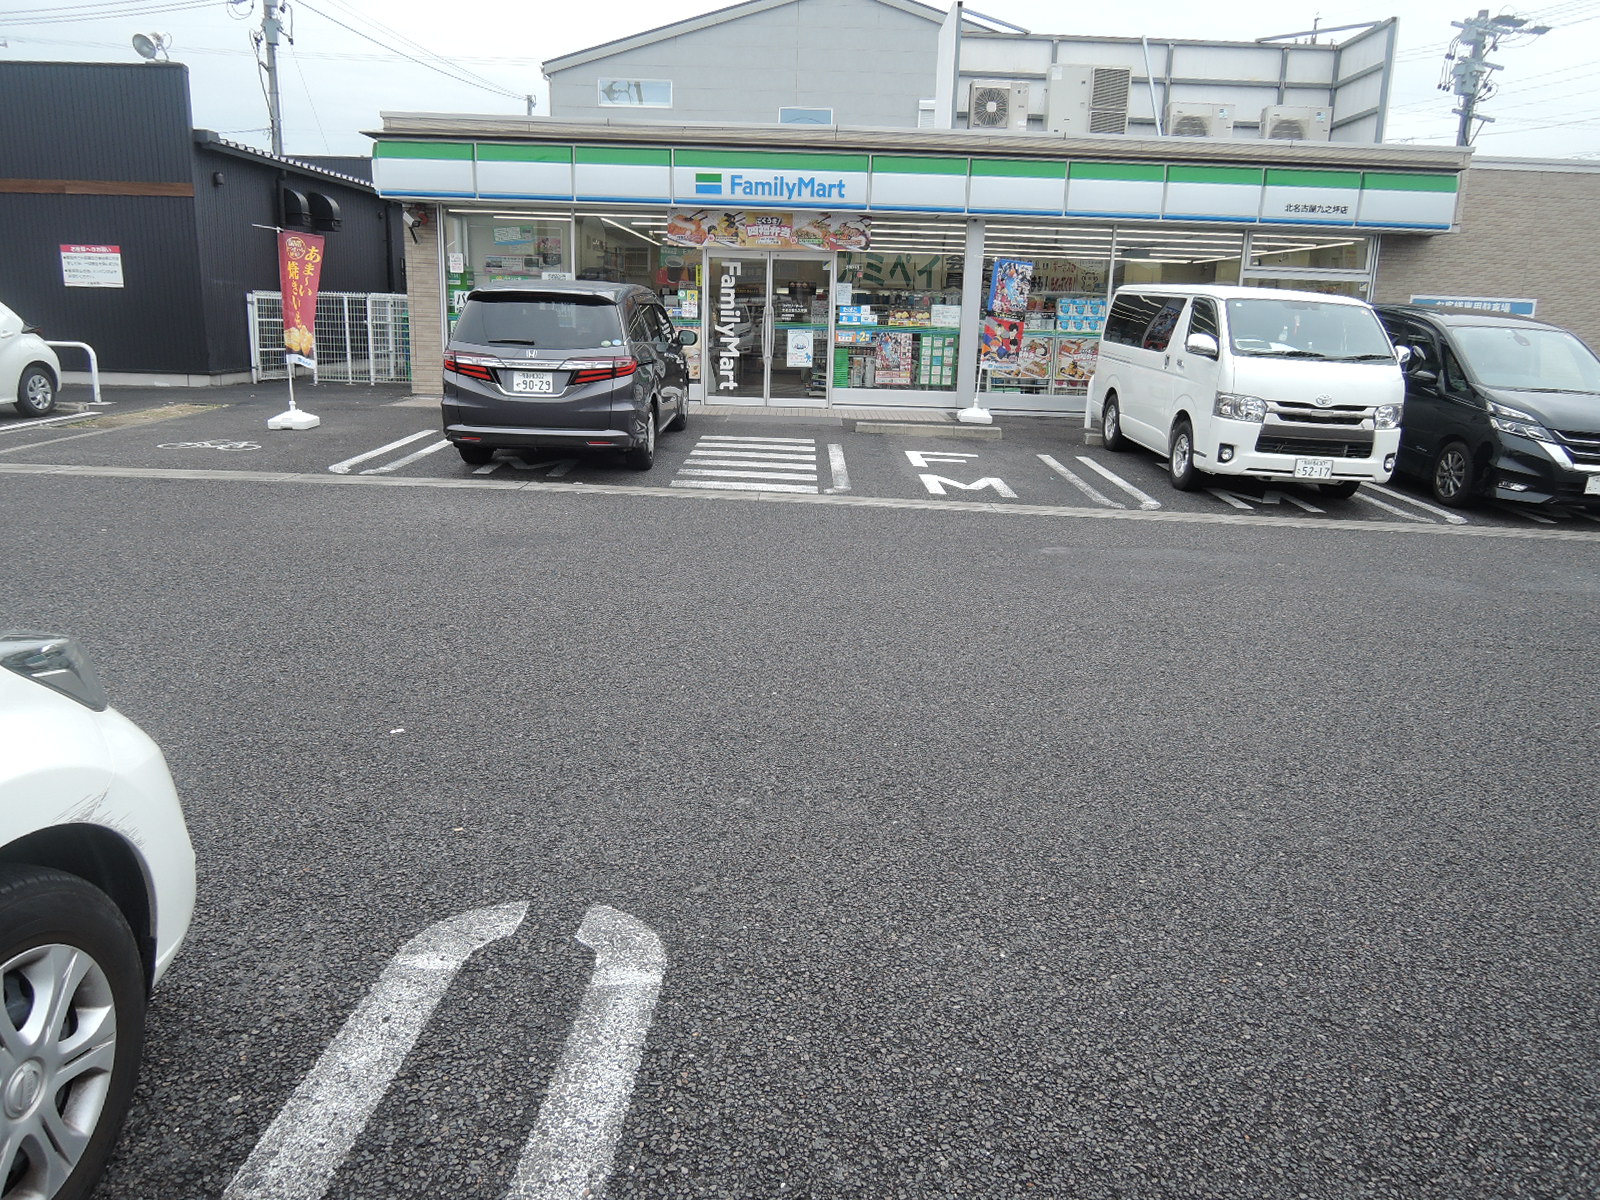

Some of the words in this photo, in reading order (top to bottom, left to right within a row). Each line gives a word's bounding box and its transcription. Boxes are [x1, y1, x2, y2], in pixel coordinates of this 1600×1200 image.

[730, 174, 846, 200] FamilyMart
[1285, 203, 1349, 215] 北名古屋九之坪店
[715, 261, 742, 390] FamilyMart
[522, 379, 551, 391] 90-29
[904, 450, 979, 467] F
[1302, 466, 1331, 477] 52-17
[918, 473, 1019, 499] M
